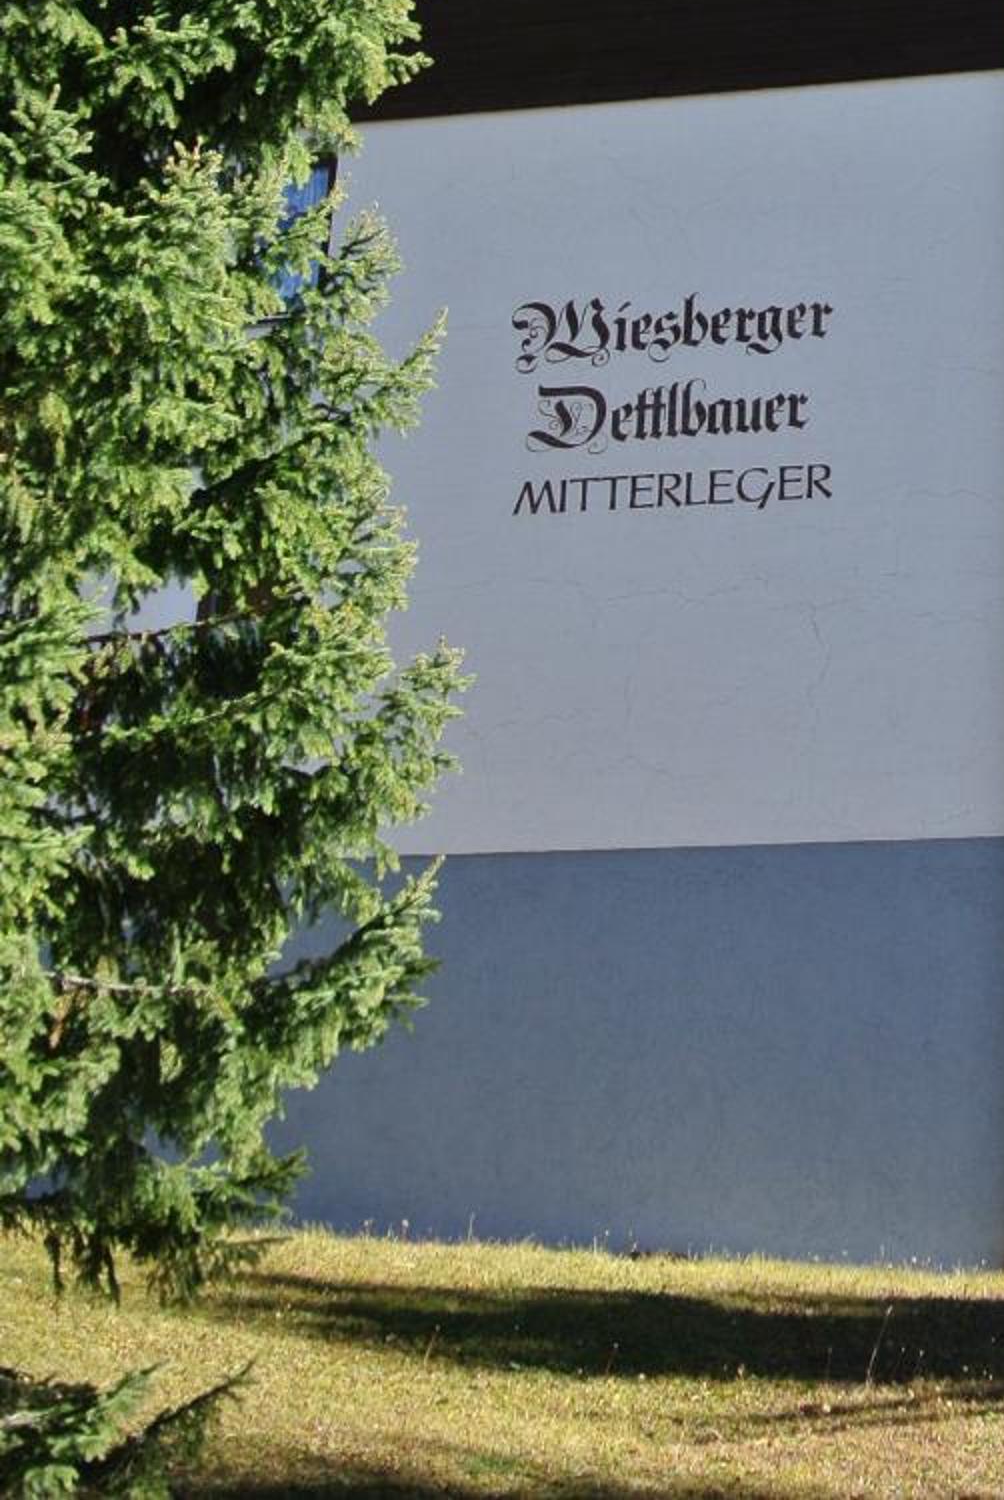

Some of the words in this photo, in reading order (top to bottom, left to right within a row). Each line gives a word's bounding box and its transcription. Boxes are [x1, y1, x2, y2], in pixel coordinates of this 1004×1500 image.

[512, 291, 834, 374] Wiesberger
[526, 378, 809, 454] Dettlbauer
[511, 463, 833, 516] MITTERLEGER
